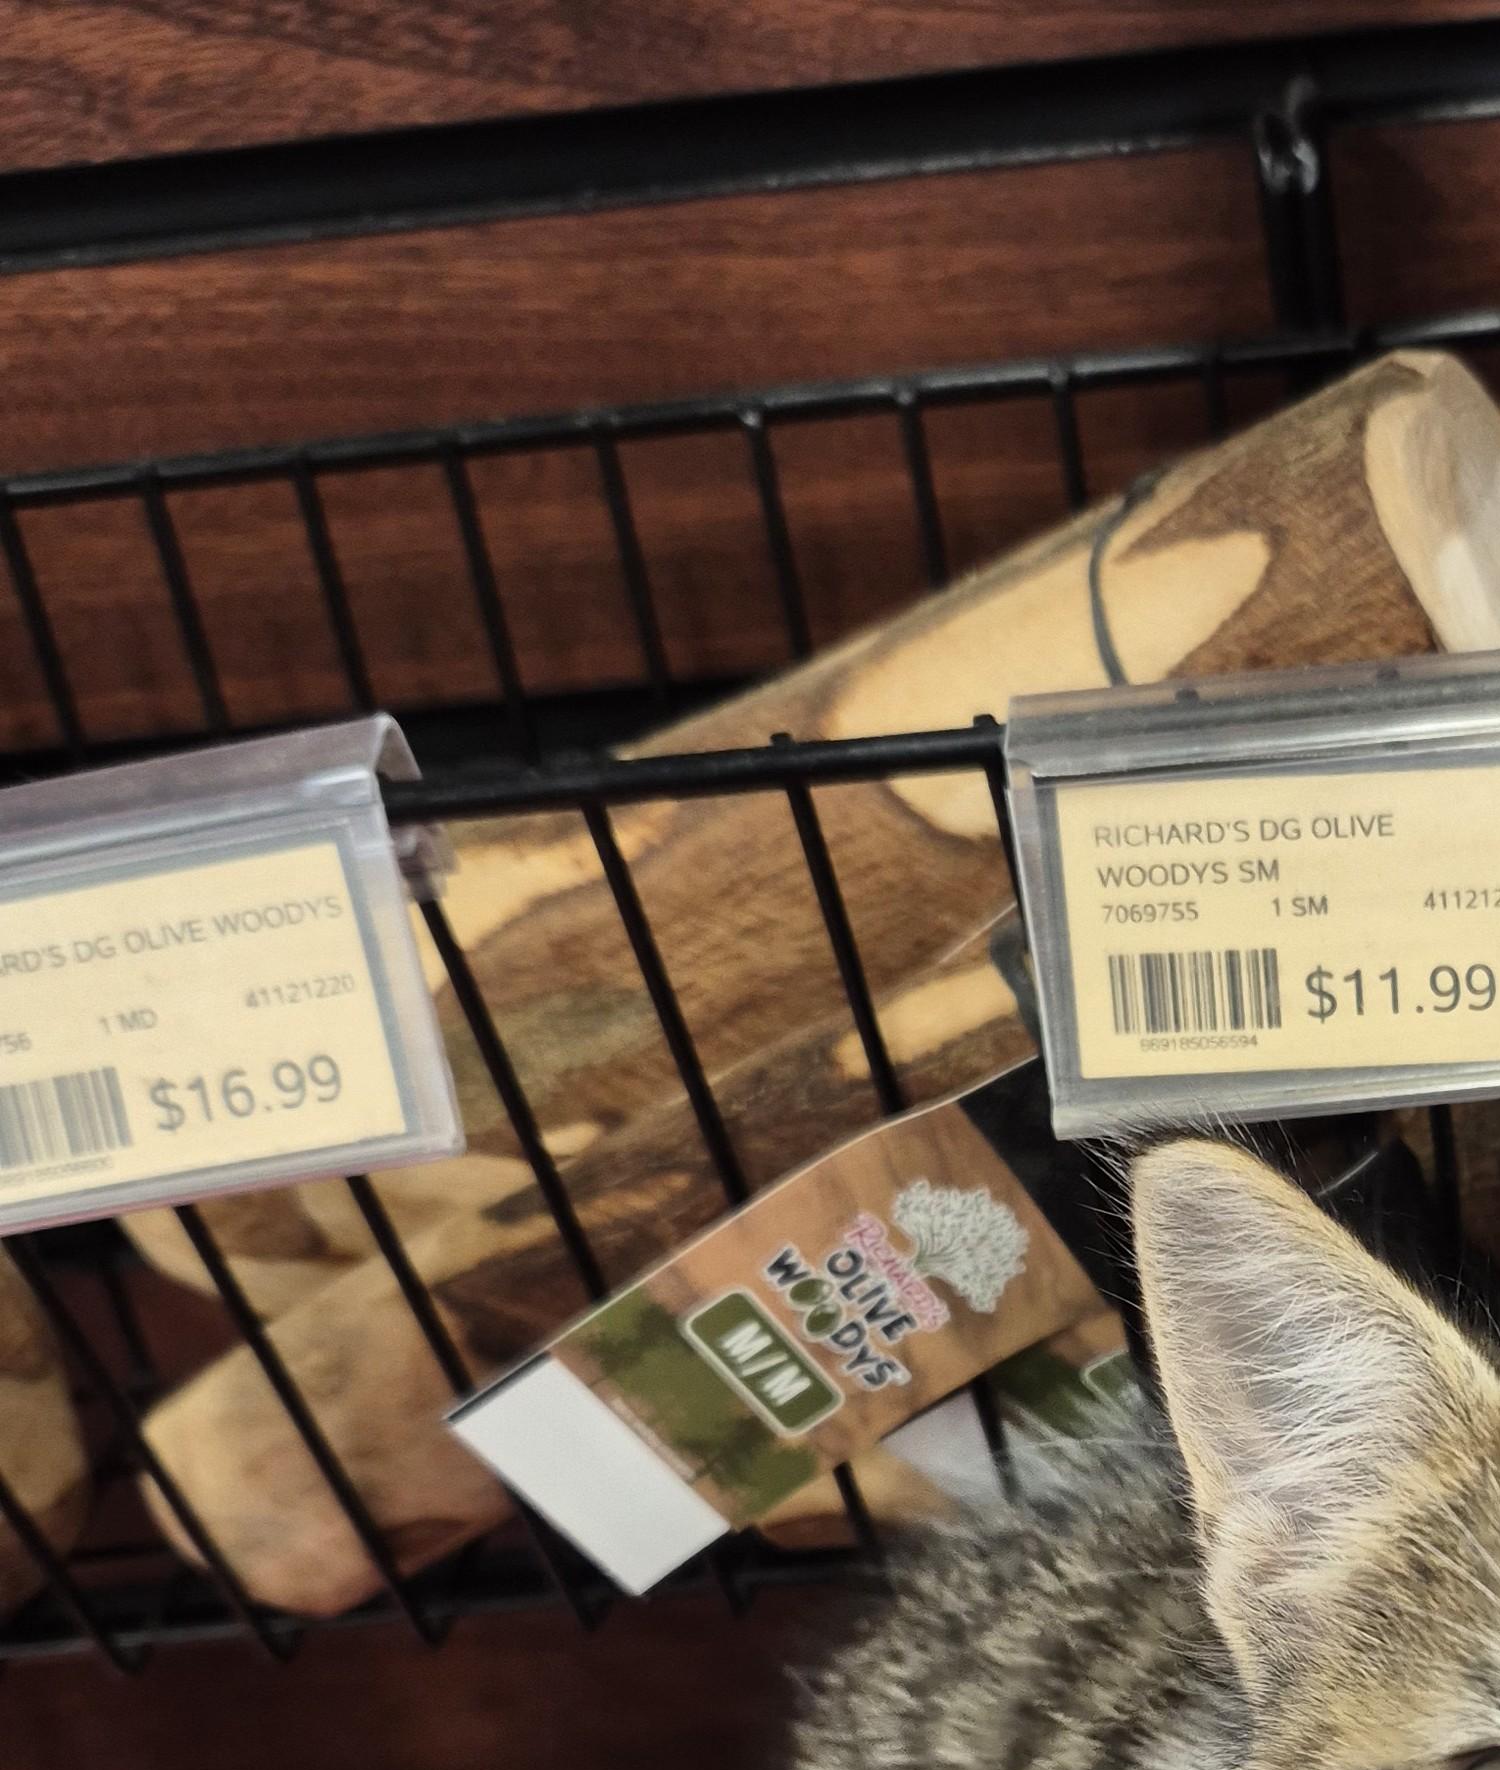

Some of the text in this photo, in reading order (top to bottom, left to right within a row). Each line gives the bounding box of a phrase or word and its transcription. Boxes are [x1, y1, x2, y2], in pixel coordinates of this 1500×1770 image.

[1093, 814, 1396, 850] RICHARD'S DG OLIVE
[1096, 859, 1281, 889] WOODYS SM
[73, 934, 117, 964] DG
[123, 919, 207, 954] OLIVE
[211, 895, 344, 937] WOODYS
[1101, 901, 1200, 925] 7069755
[1271, 896, 1329, 919] 1 SM
[244, 973, 356, 1009] 41121220
[1304, 963, 1498, 1024] $11.99
[120, 1007, 159, 1034] MD
[149, 1053, 343, 1134] $16.99
[766, 1248, 898, 1387] WOODYS
[826, 1249, 918, 1341] OLIVE
[720, 1320, 813, 1408] M/M
